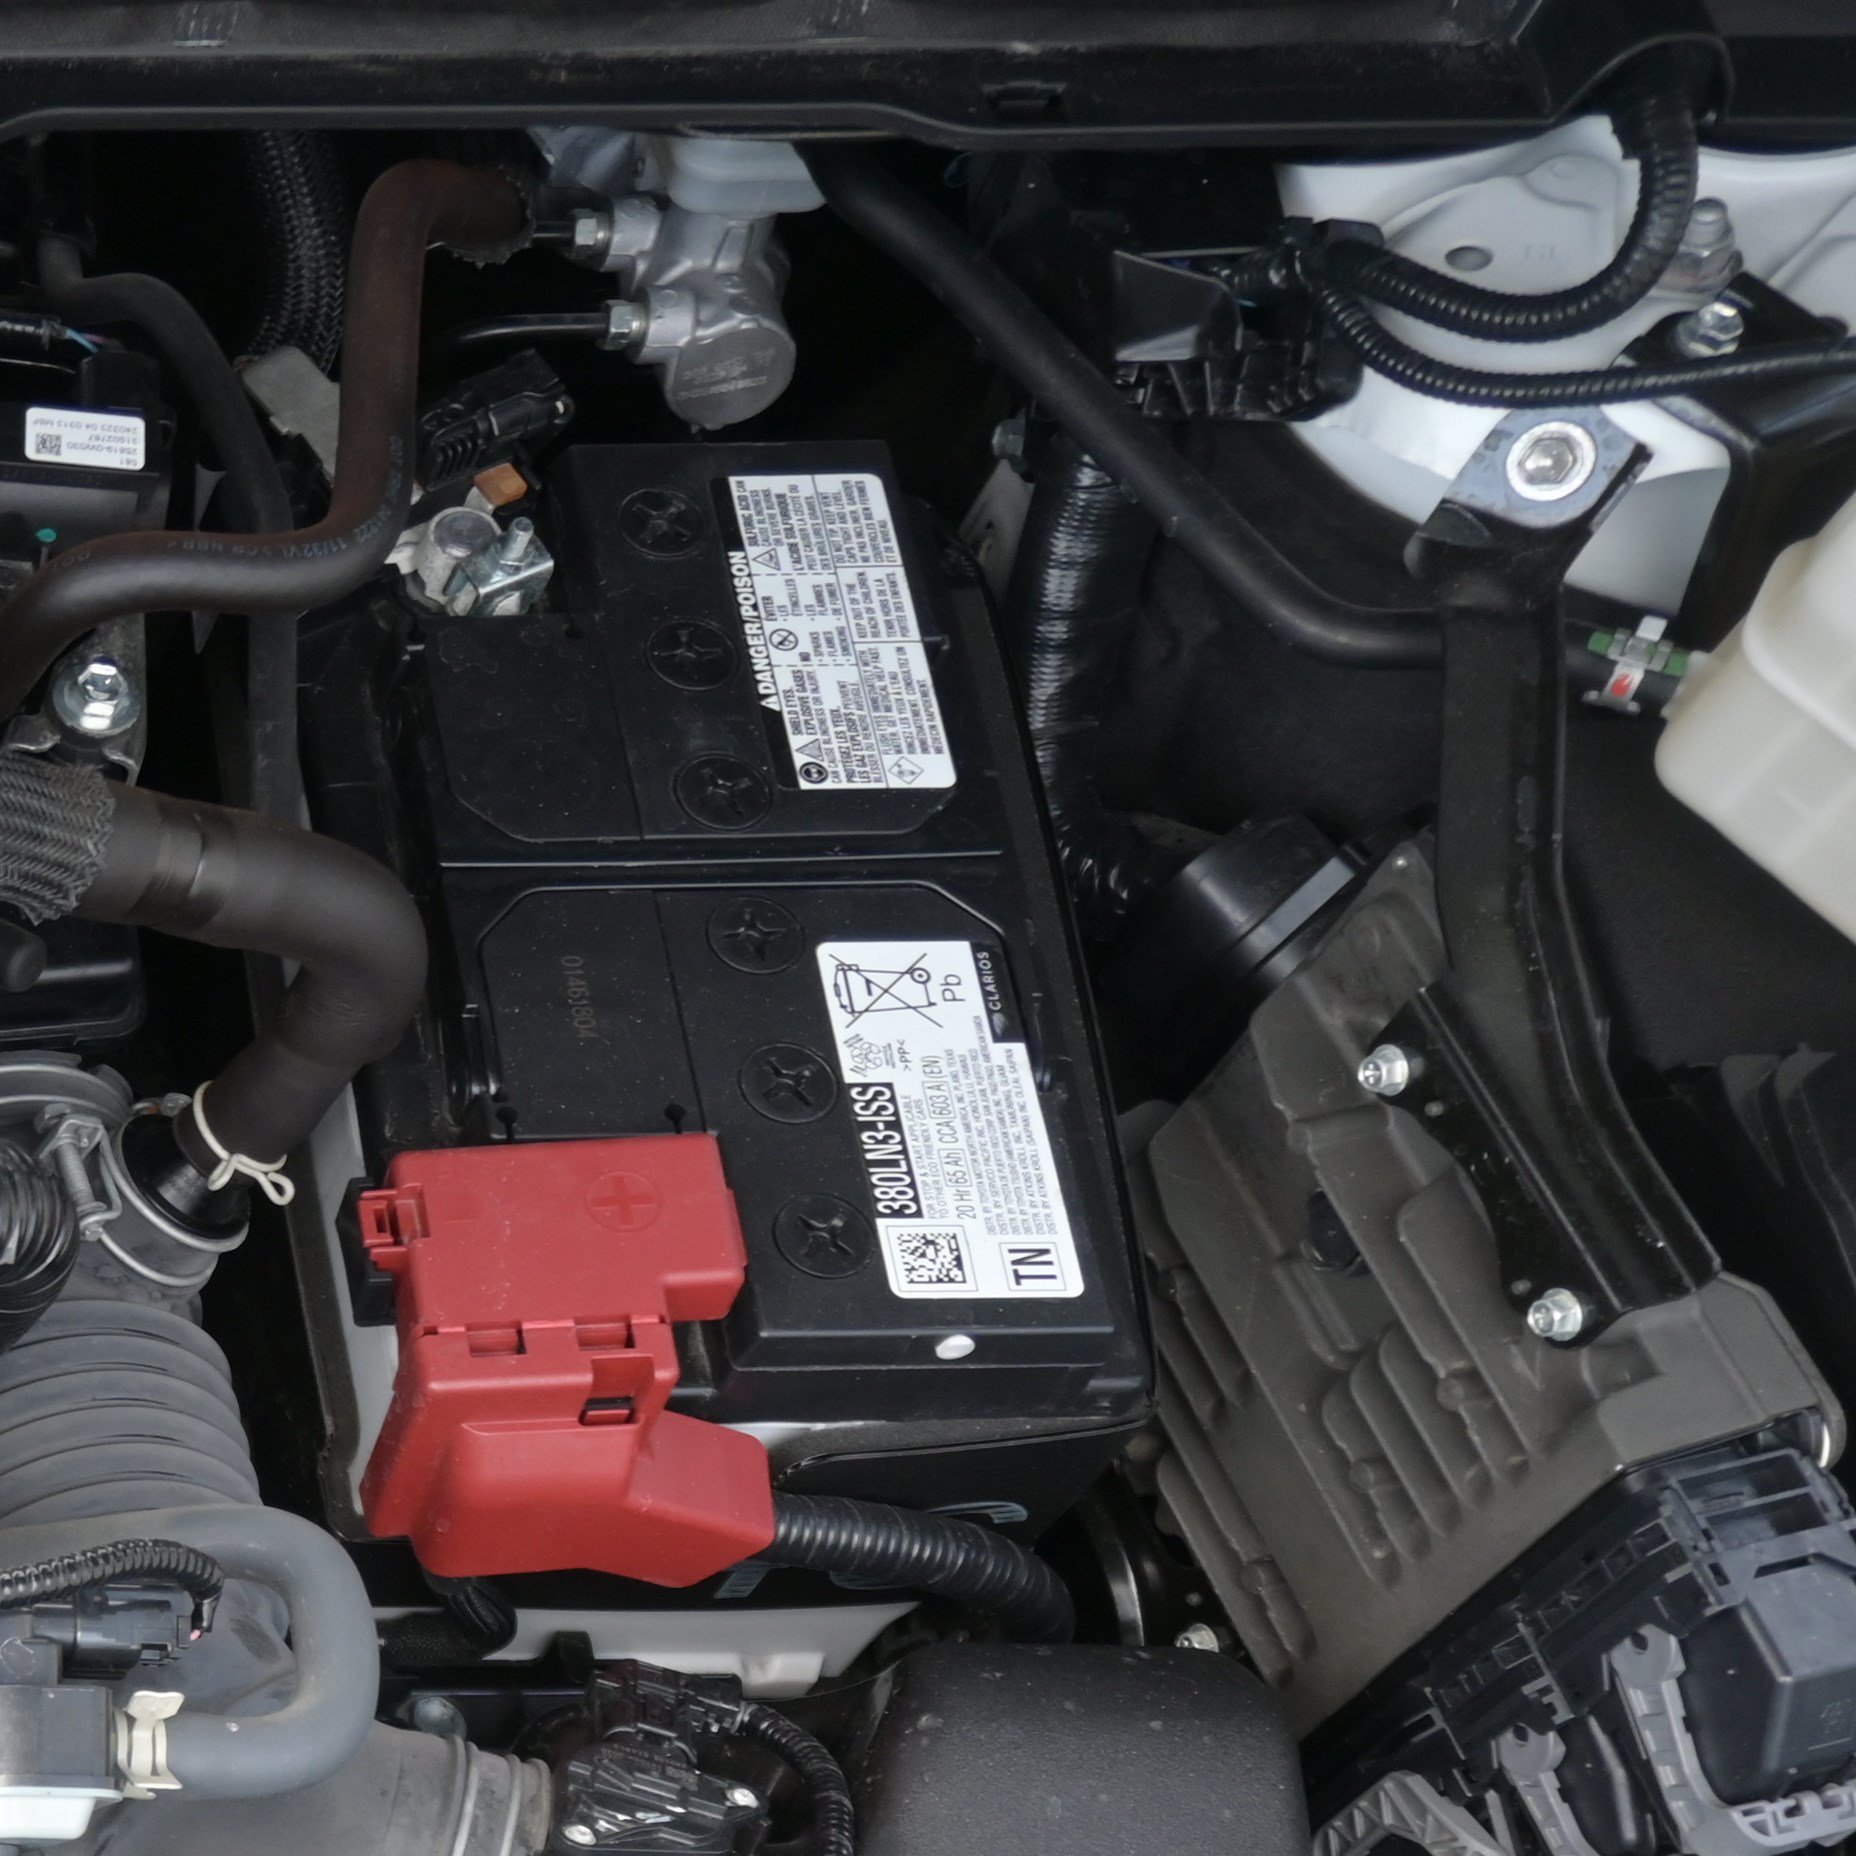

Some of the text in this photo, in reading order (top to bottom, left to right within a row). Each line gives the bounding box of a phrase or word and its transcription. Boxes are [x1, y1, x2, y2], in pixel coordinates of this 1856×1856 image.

[726, 551, 776, 694] DANGER/POISON
[938, 974, 964, 1001] Pb
[976, 951, 1001, 1010] CLARIOS
[901, 1094, 921, 1141] APPLICABLE
[921, 1055, 976, 1219] 20 Hr 65 Ah CCA 603 A (EN)
[849, 1086, 918, 1214] 380LN3-ISS
[912, 1144, 927, 1169] START
[914, 1098, 949, 1218] TO OTHER ECO FRIENDLY CARS
[920, 1180, 934, 1200] STOP
[925, 1203, 938, 1218] FOR
[1007, 1247, 1059, 1285] TN
